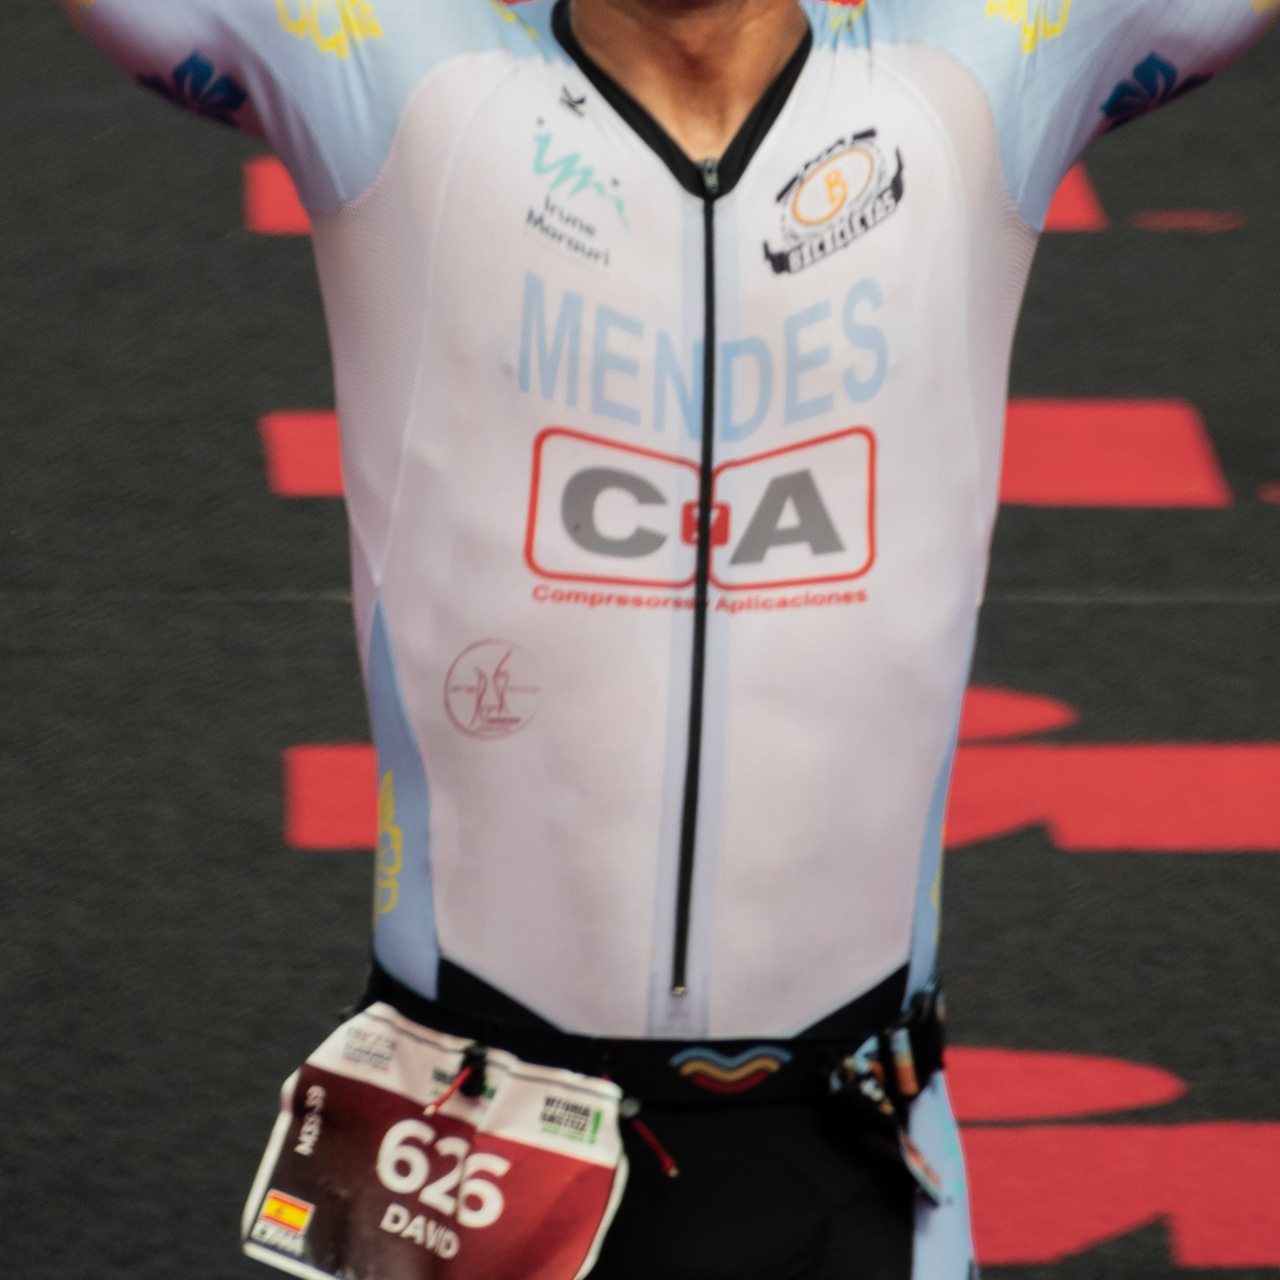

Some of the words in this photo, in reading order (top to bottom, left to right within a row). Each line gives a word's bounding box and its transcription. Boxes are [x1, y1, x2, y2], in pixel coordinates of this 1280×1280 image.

[517, 275, 889, 443] MENDES
[532, 584, 694, 611] Compresores
[716, 587, 866, 614] Aplicaciones
[376, 1118, 513, 1229] 626
